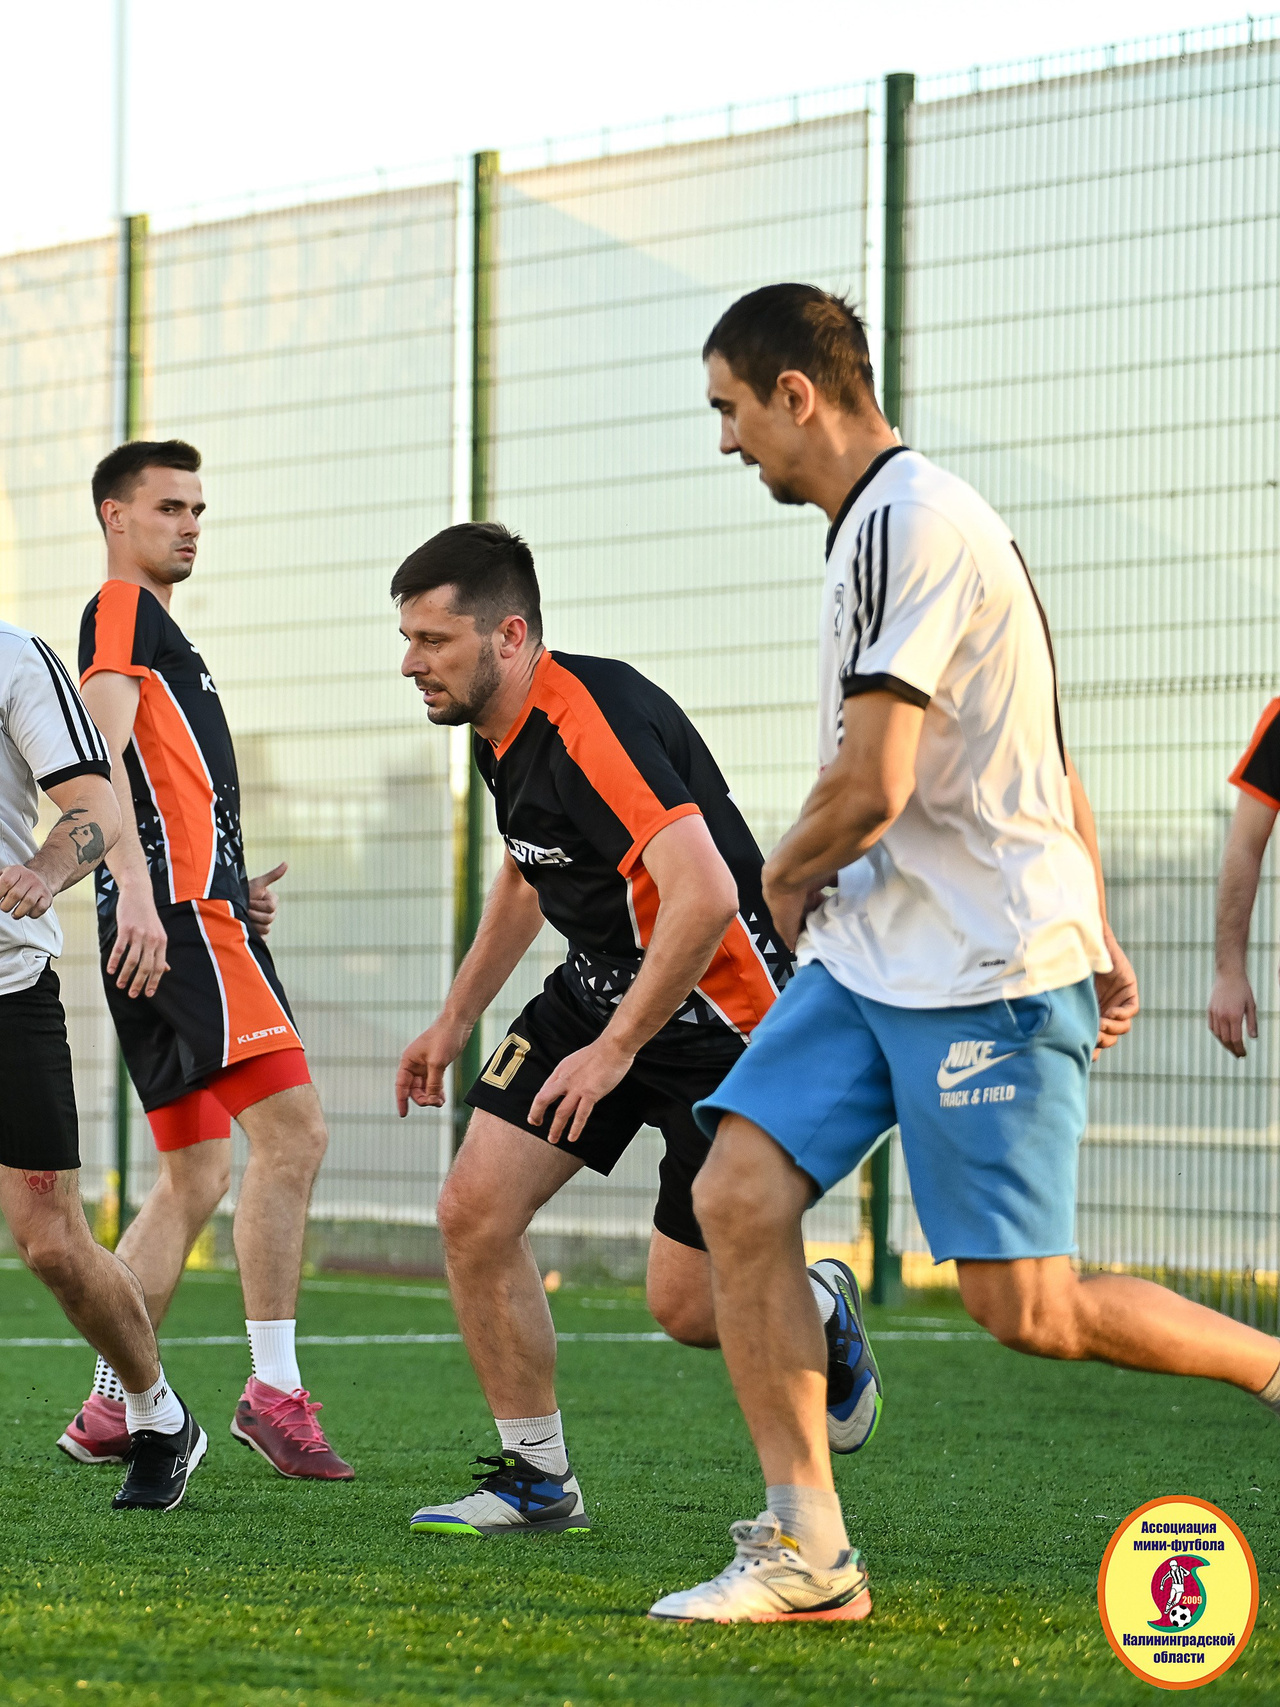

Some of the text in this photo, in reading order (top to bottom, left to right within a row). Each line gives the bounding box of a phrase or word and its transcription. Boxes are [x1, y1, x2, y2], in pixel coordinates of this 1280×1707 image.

[236, 1025, 287, 1045] KLESTER
[943, 1040, 996, 1069] NIKE
[939, 1084, 1016, 1107] TRACK & FIELD
